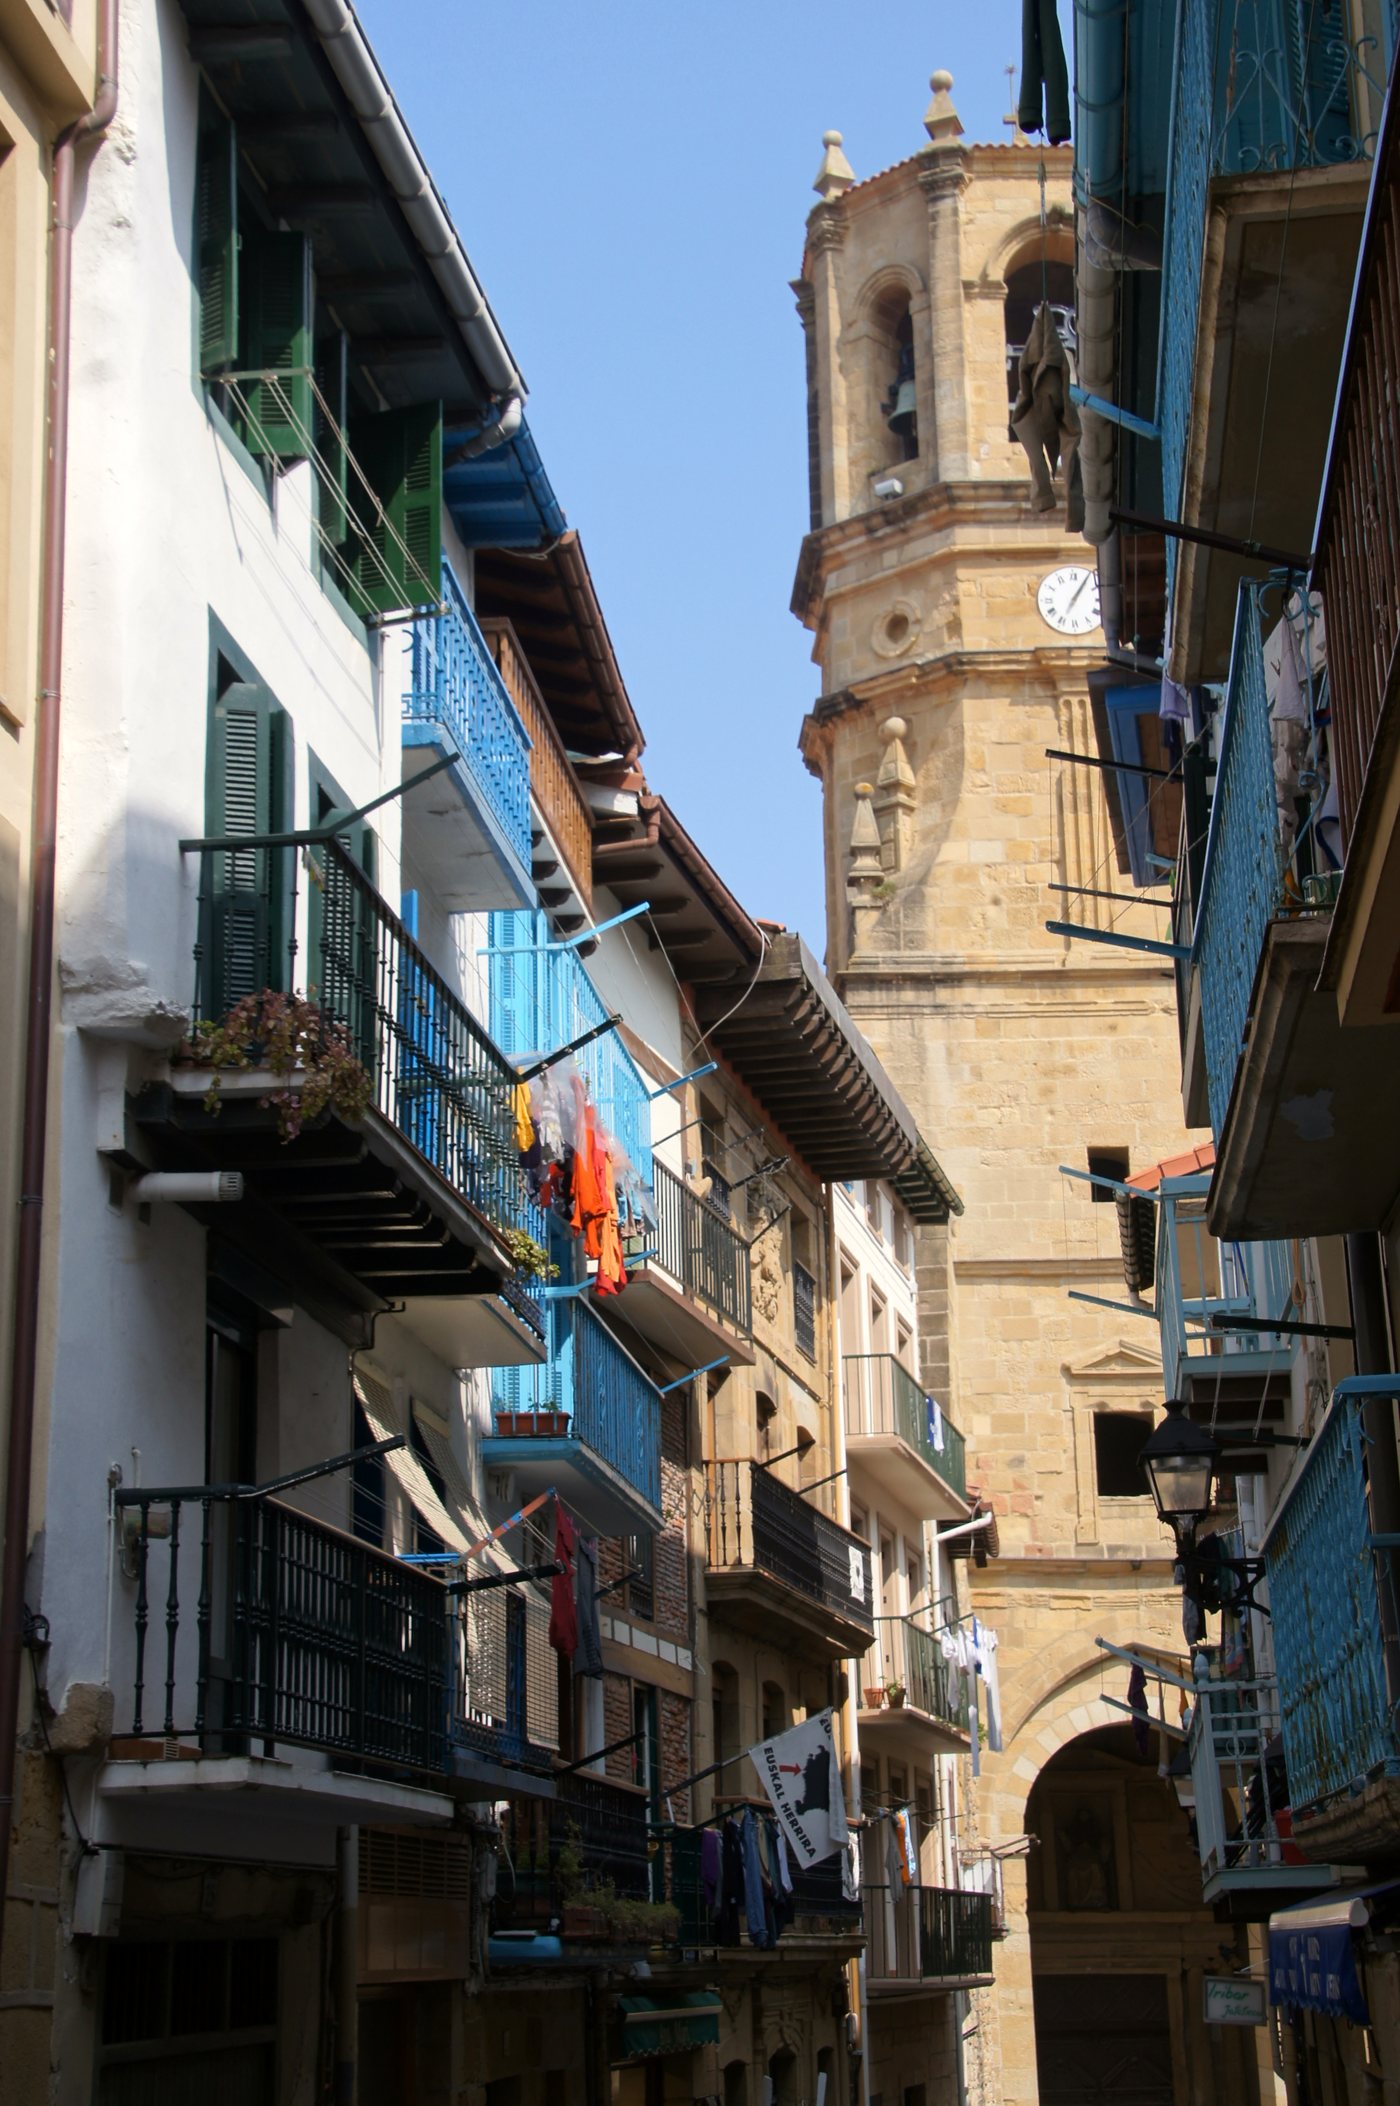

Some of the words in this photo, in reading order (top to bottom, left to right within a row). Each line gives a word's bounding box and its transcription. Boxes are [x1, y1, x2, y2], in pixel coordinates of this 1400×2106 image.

[764, 1747, 785, 1800] EUSKAL
[781, 1802, 817, 1858] HERRIRA
[1208, 1982, 1249, 2000] Iribar
